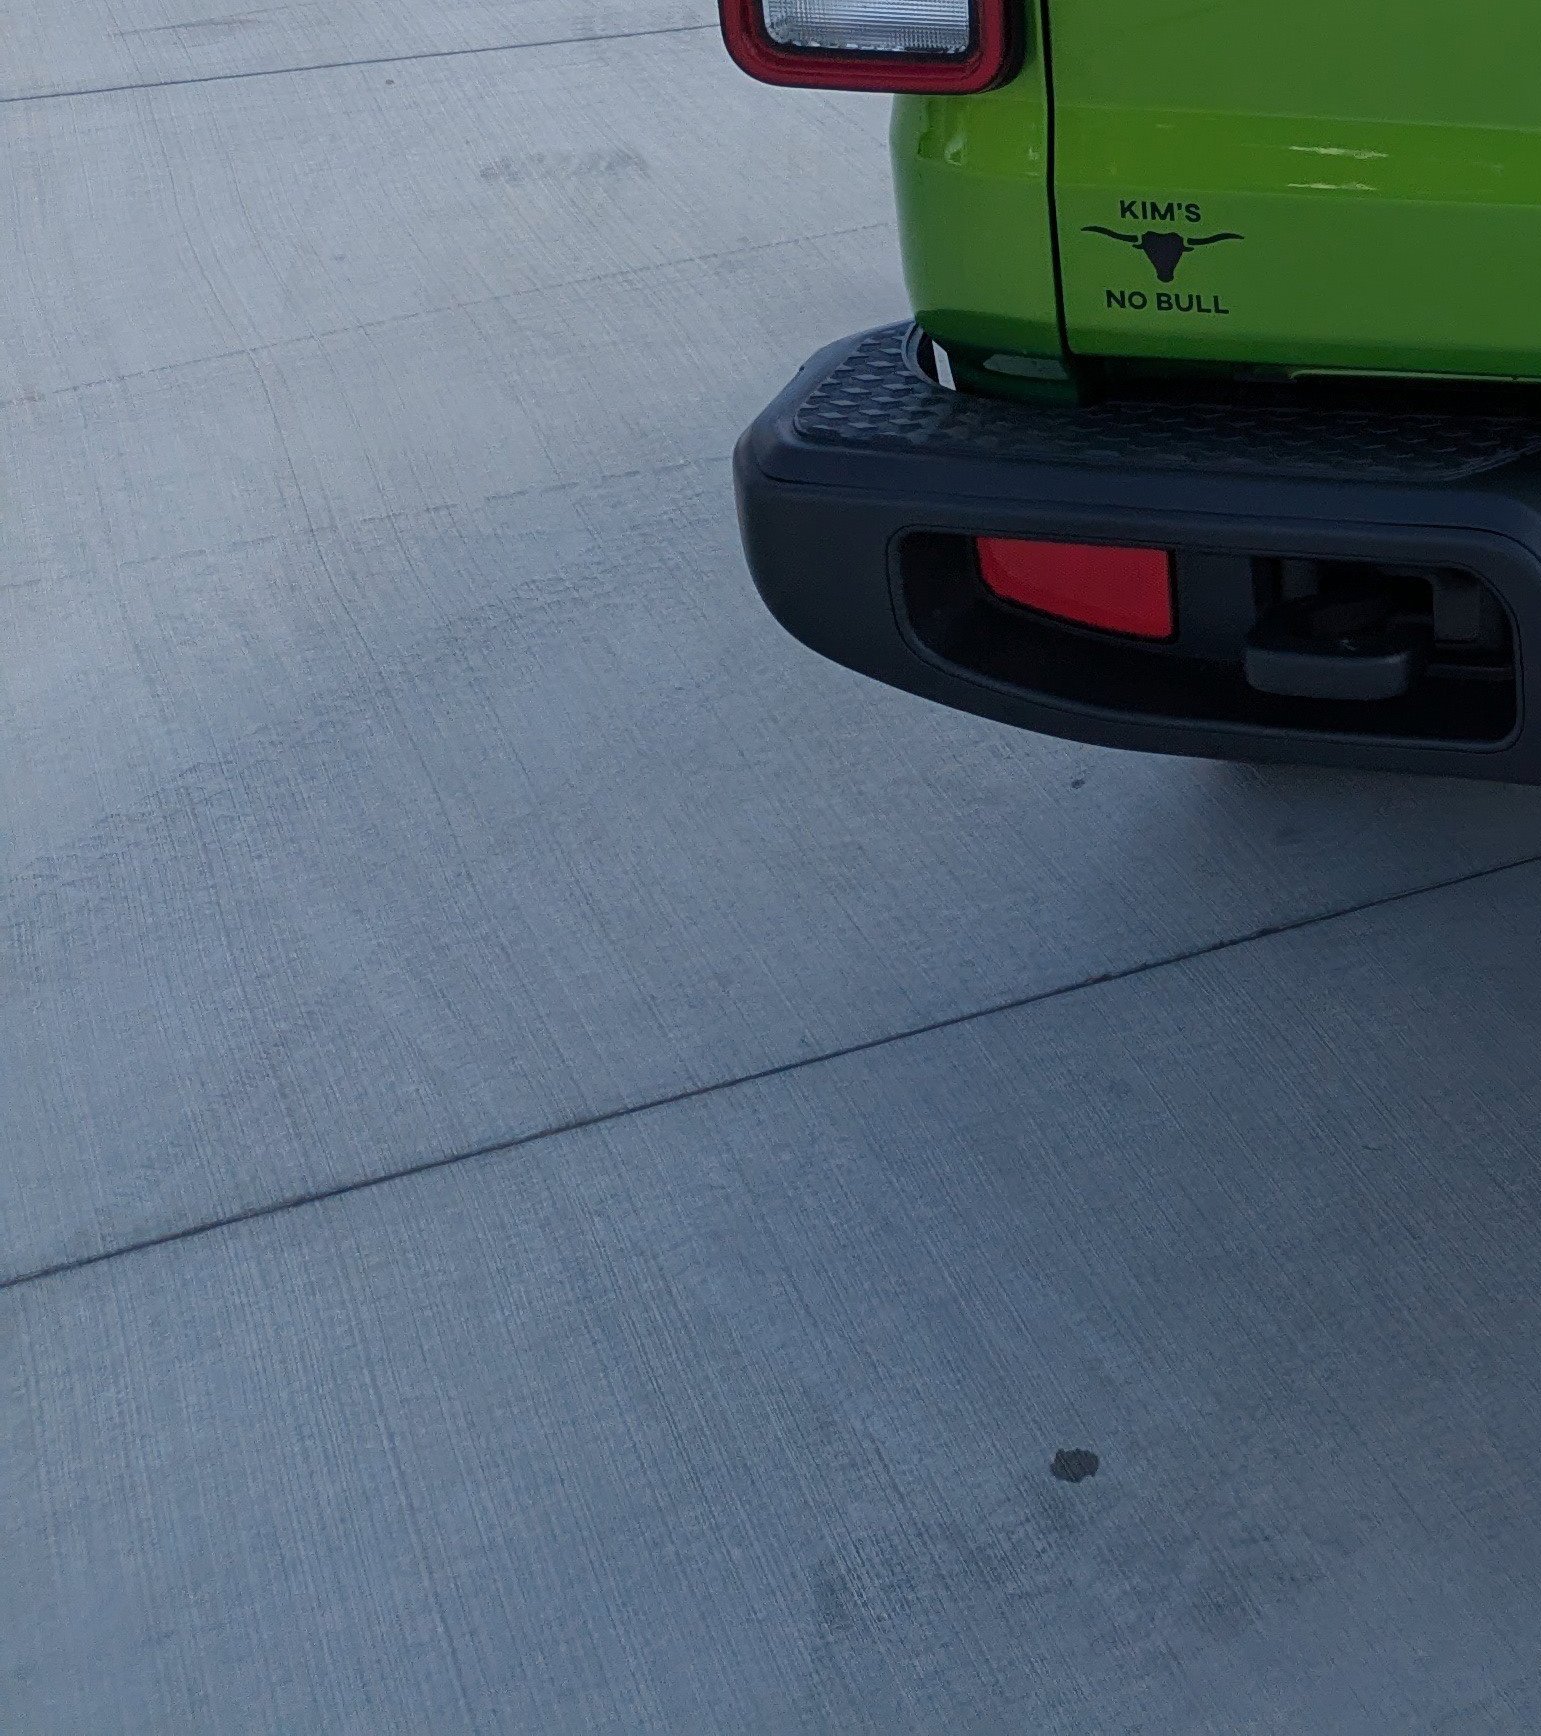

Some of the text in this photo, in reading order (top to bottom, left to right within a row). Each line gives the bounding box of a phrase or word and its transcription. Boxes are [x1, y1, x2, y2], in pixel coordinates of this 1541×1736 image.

[1119, 199, 1202, 223] KIM'S
[1105, 289, 1230, 315] NO BULL
